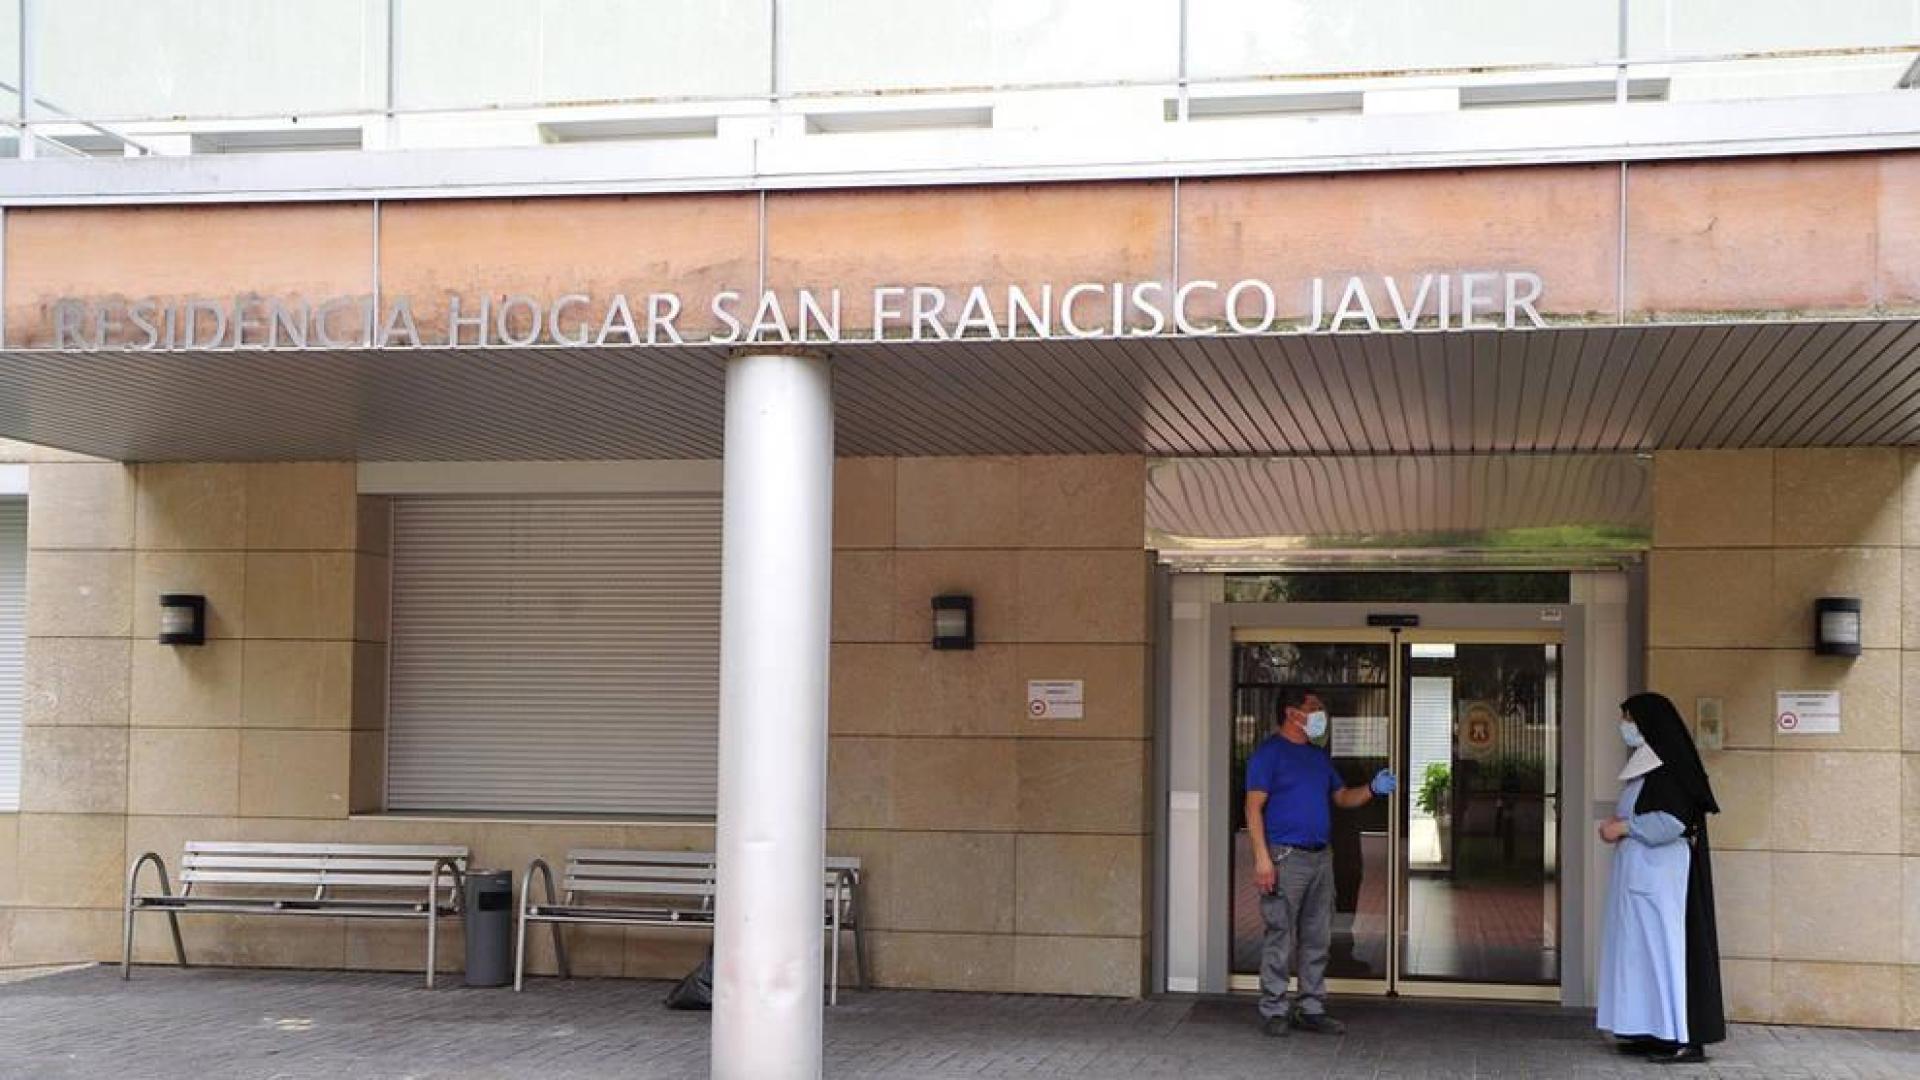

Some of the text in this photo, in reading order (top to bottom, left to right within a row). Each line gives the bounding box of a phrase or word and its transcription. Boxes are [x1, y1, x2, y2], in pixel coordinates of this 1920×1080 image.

[56, 272, 1545, 352] RESIDENCIA HOGAR SAN FRANCISCO JAVIER
